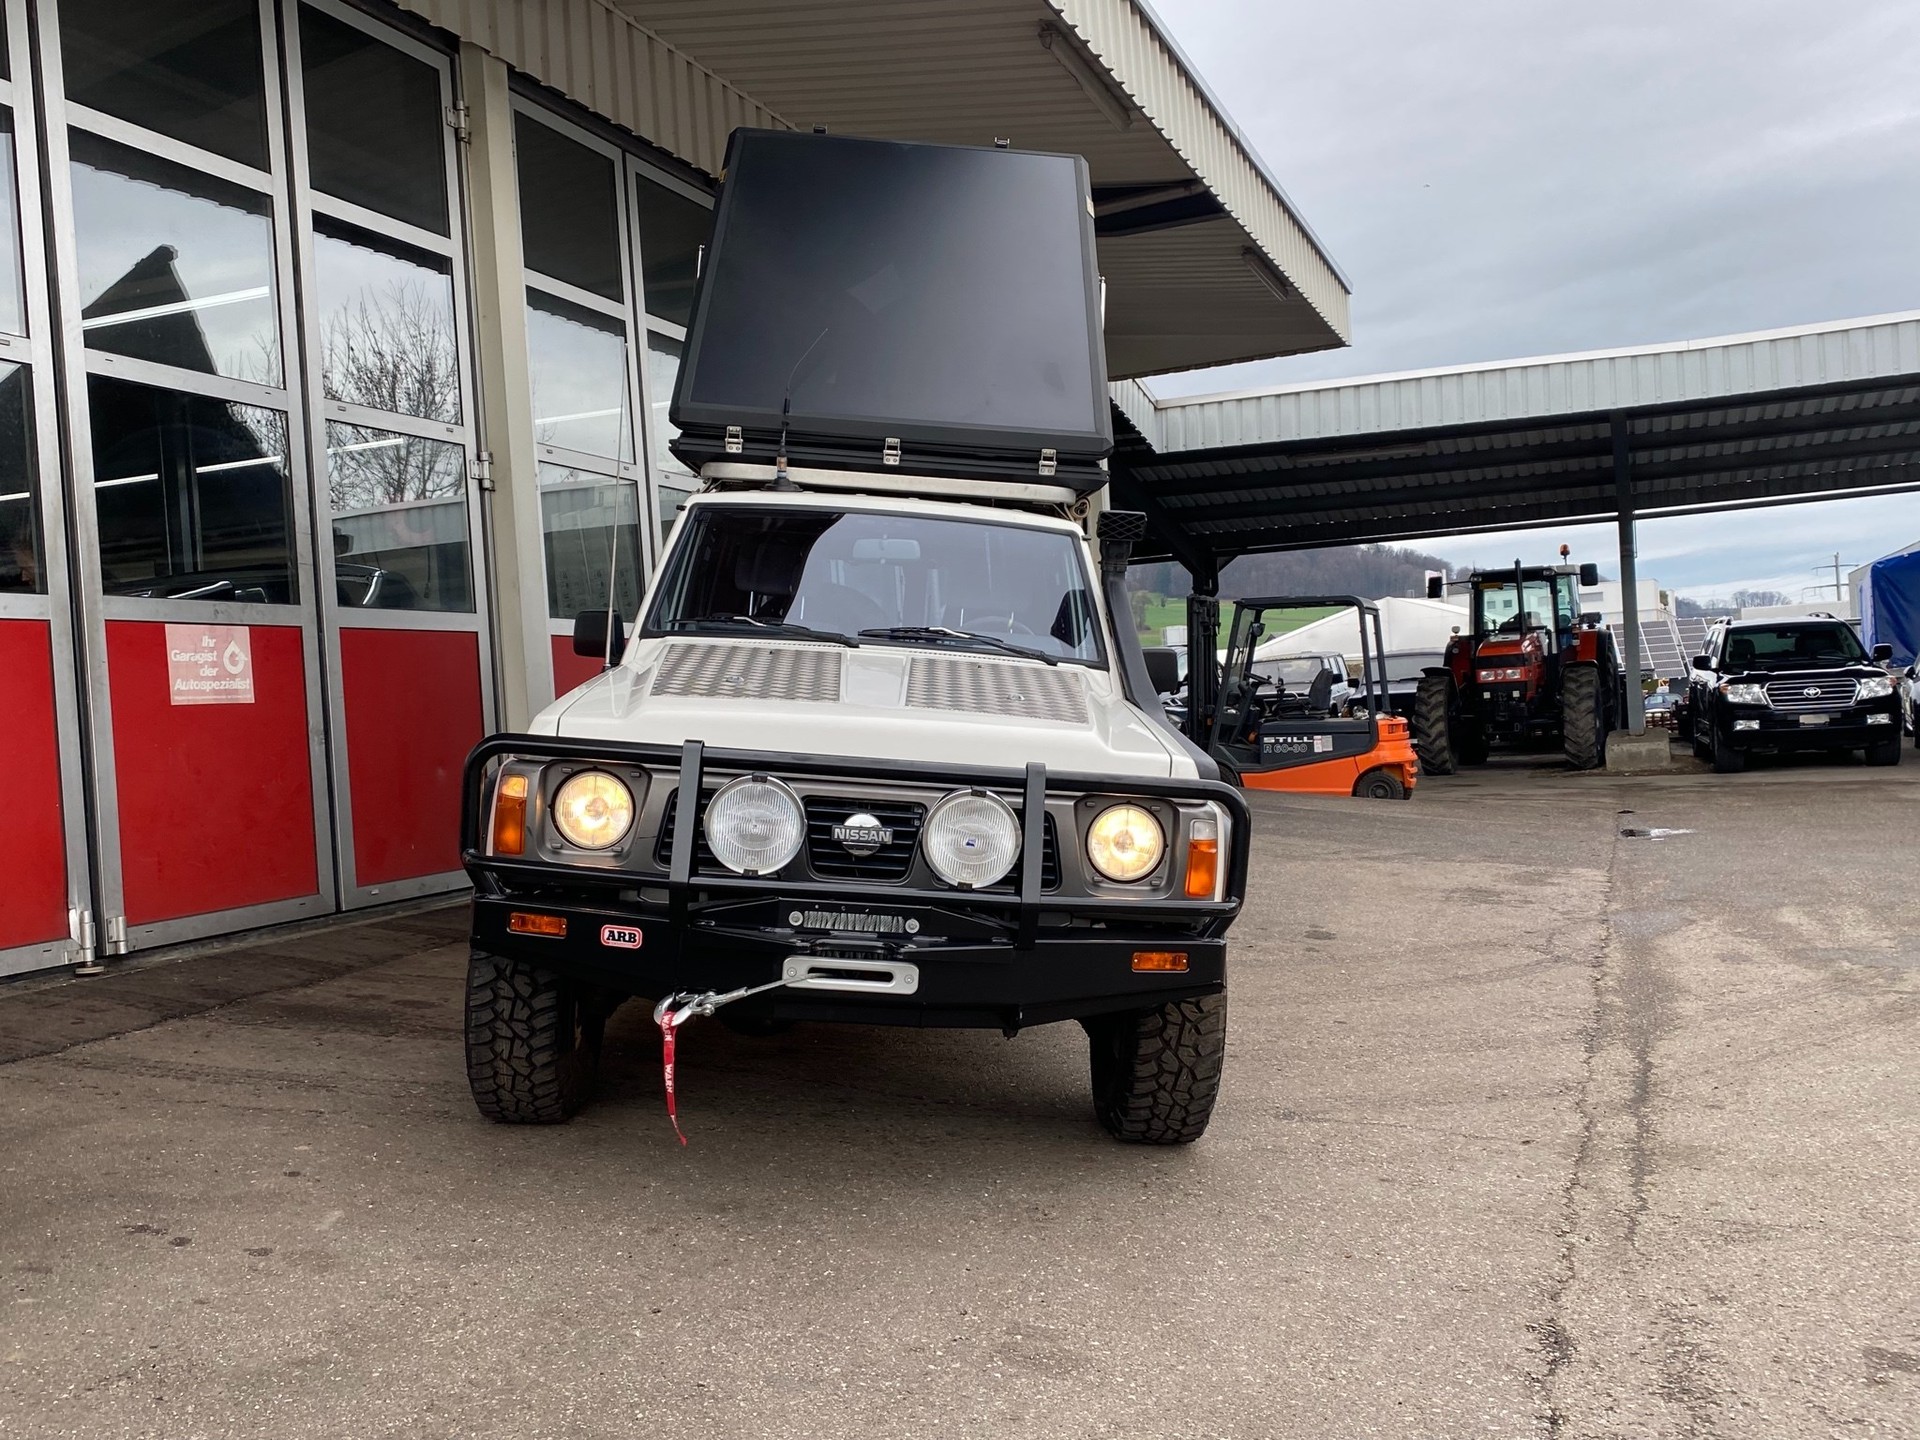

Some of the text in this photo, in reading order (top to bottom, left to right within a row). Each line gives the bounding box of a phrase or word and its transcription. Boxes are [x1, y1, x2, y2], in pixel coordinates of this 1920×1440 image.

[202, 635, 216, 648] Ihr
[171, 649, 217, 664] Garagist
[200, 665, 219, 677] der
[174, 678, 250, 692] Autospezialist
[1263, 743, 1273, 753] R
[834, 827, 890, 842] NISSAN
[606, 929, 638, 944] ARB
[664, 1063, 673, 1093] WARN
